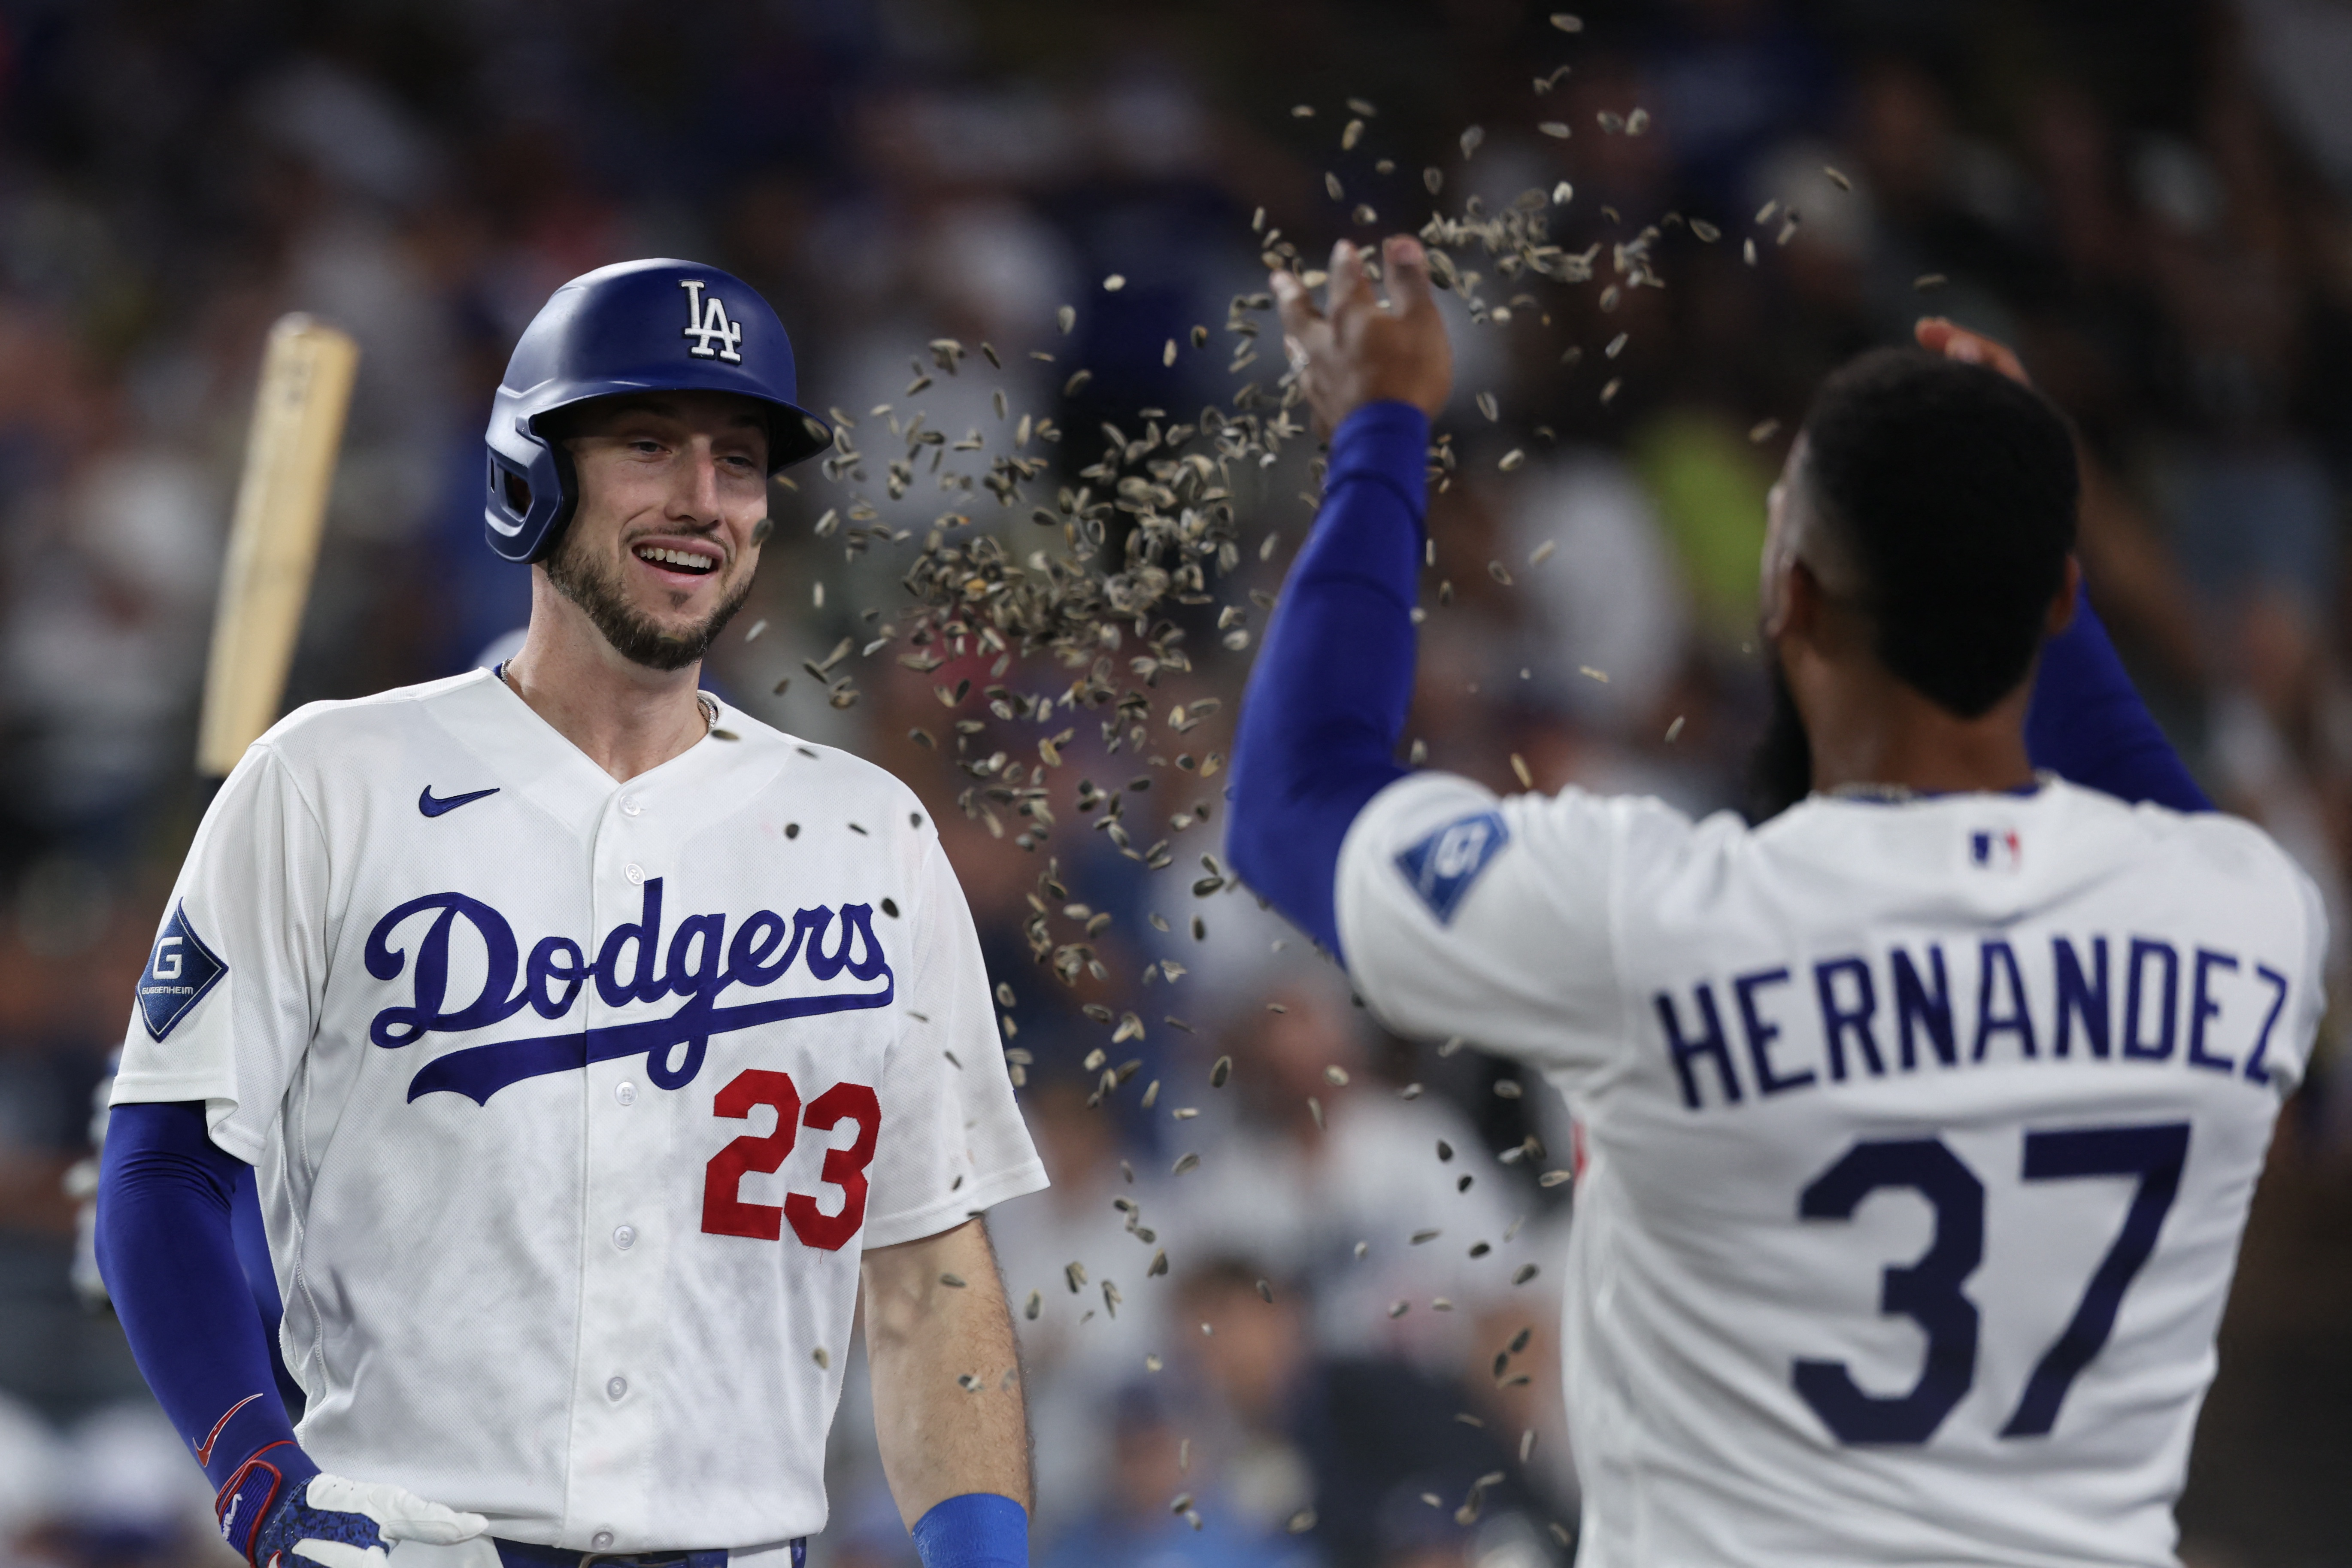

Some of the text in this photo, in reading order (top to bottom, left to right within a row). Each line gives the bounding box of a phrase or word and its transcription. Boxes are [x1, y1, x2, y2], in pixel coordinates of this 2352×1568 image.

[680, 280, 741, 364] LA
[142, 986, 194, 995] GUGGENHEIM
[153, 937, 183, 980] G
[365, 877, 894, 1107] Dodgers
[1655, 936, 2290, 1112] HERNANDEZ
[702, 1069, 881, 1250] 23
[1789, 1122, 2192, 1448] 37
